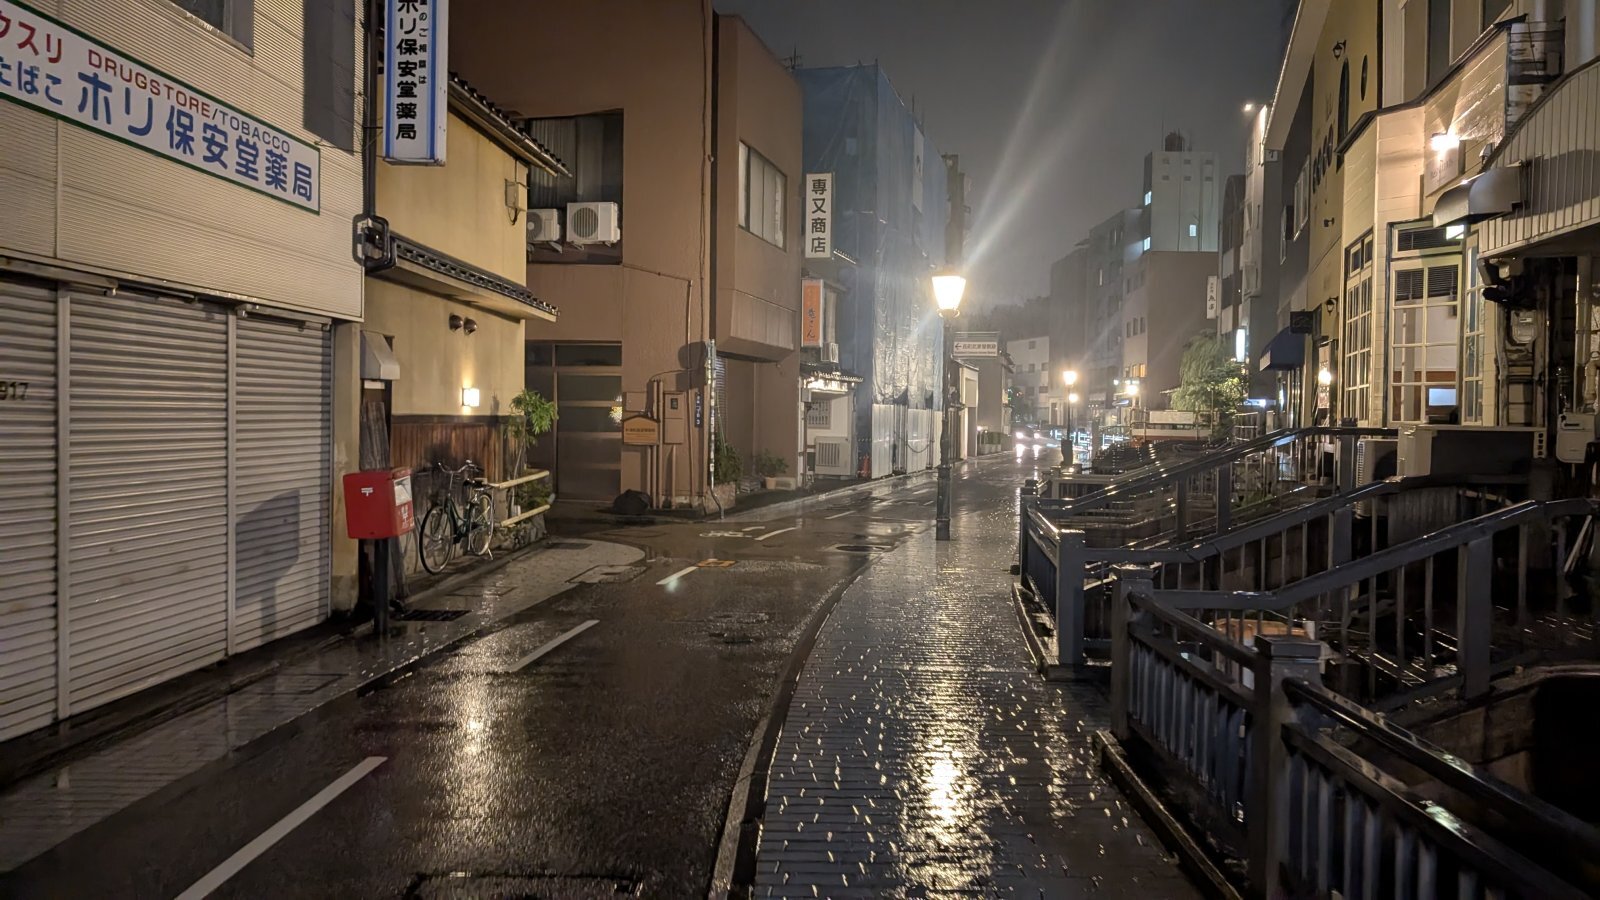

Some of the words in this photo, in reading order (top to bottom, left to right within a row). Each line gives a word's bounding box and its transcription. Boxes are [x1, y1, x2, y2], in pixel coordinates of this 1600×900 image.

[88, 49, 291, 154] DRUGSTORE/TOBACCO
[396, 0, 419, 140] ホリ保安堂薬局
[77, 71, 313, 202] ホリ保安堂薬局
[811, 179, 827, 253] 専又商店
